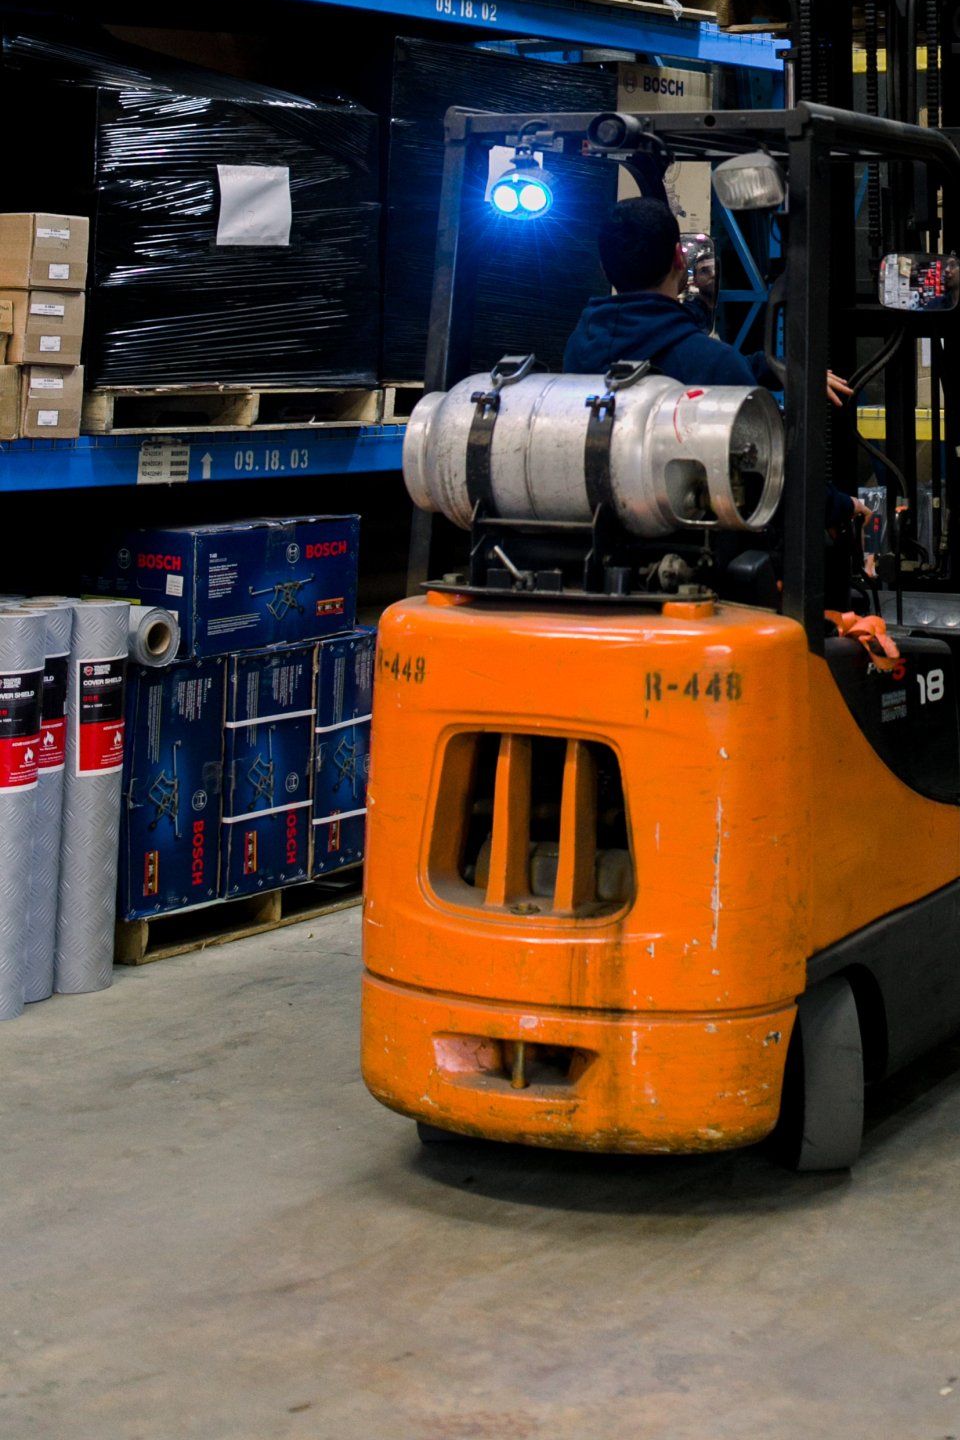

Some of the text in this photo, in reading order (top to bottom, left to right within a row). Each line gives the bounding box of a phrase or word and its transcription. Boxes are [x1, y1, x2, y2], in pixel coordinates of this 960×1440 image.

[643, 76, 684, 97] BOSCH
[305, 540, 347, 559] BOSCH
[137, 553, 182, 571] BOSCH
[83, 676, 122, 687] COVER SHIELD
[644, 670, 743, 702] R-448
[916, 668, 945, 705] 18
[14, 690, 35, 699] SHIELD
[191, 820, 205, 885] BOSCH
